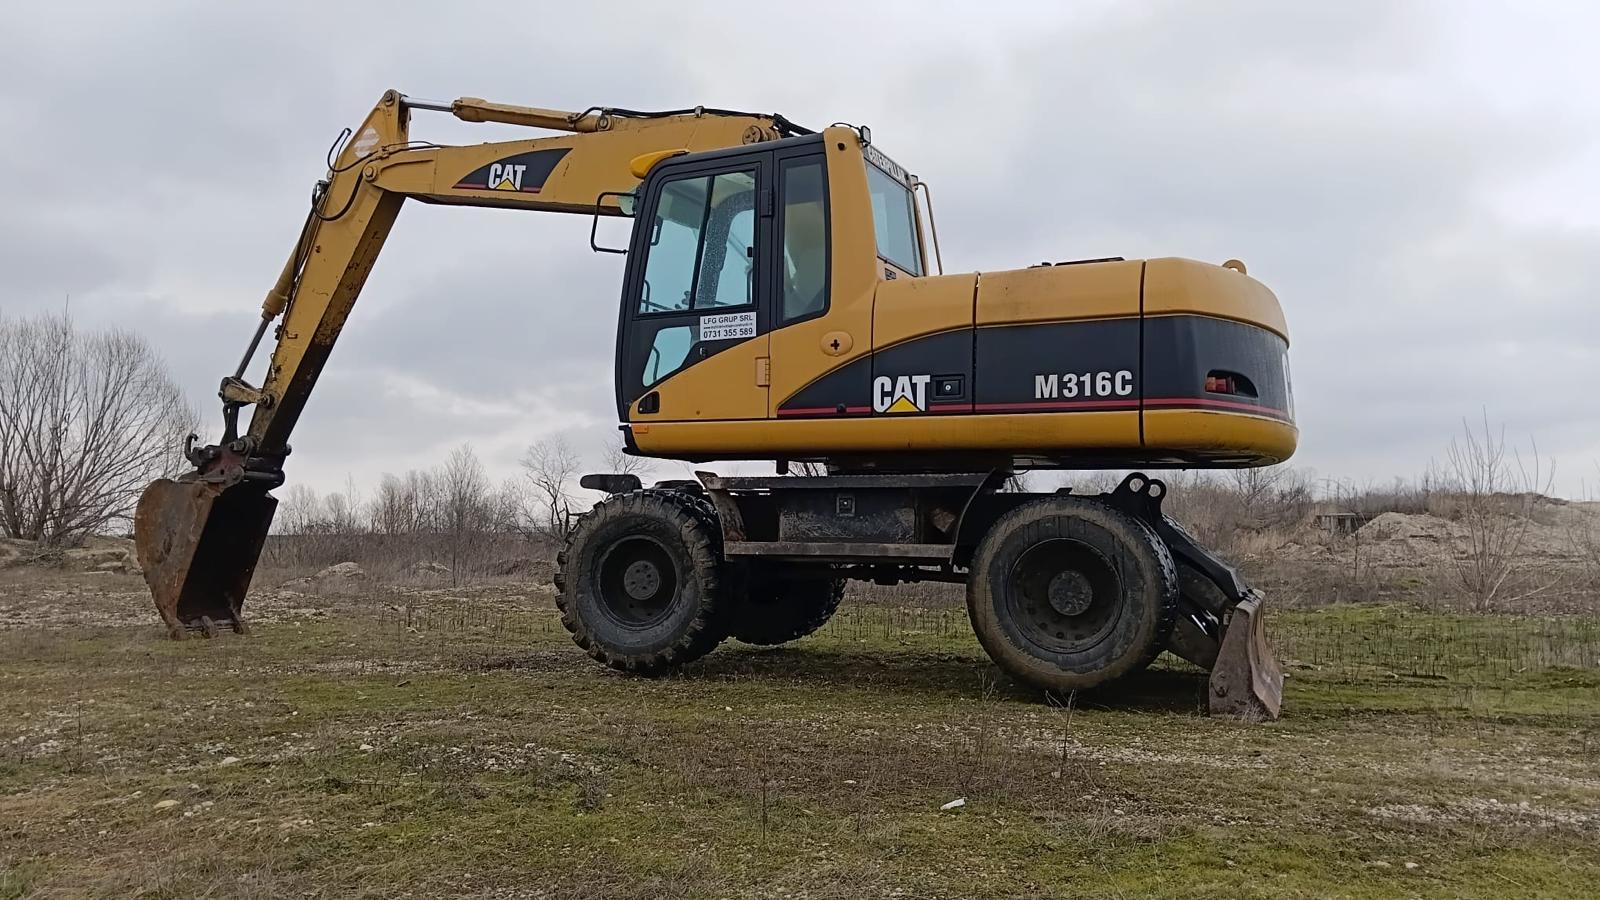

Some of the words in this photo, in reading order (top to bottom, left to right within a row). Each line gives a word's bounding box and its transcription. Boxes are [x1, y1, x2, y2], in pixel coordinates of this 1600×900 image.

[488, 163, 527, 191] CAT
[718, 315, 738, 323] GRUP
[703, 330, 721, 338] 0731
[723, 329, 738, 337] 355
[739, 327, 753, 336] 589
[873, 374, 931, 413] CAT
